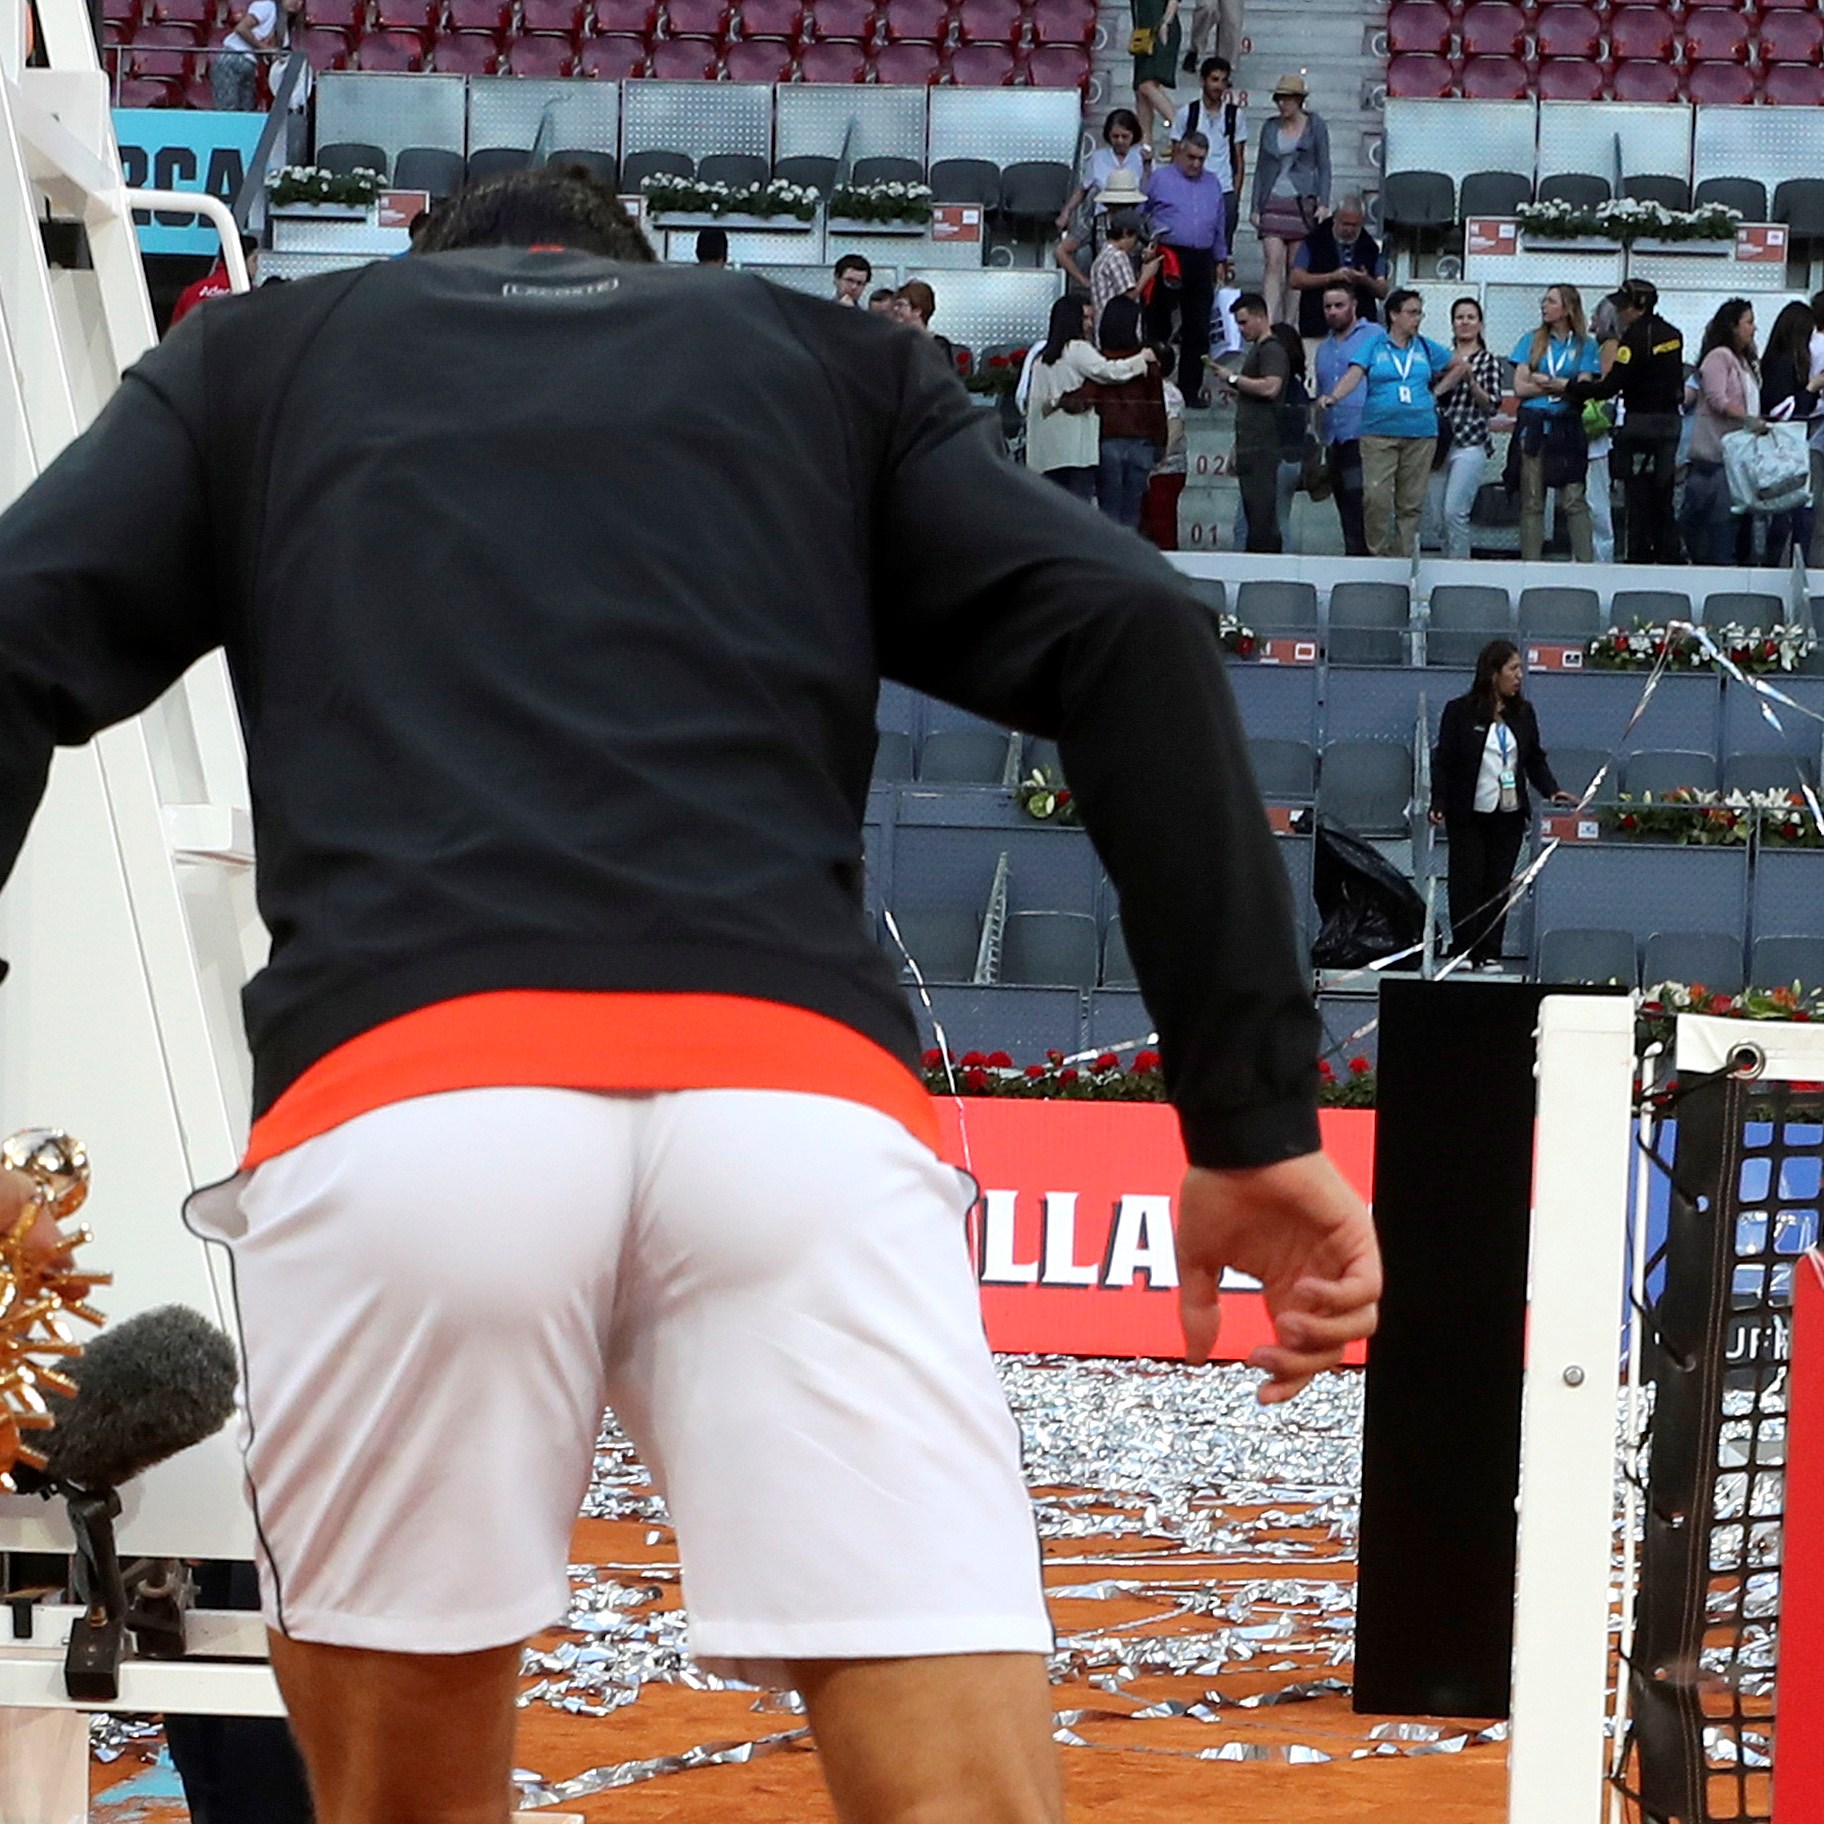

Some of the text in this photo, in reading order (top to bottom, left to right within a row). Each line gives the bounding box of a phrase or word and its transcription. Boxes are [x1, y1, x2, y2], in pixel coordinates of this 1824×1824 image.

[119, 145, 244, 228] RCA
[1197, 455, 1225, 475] 02
[1191, 523, 1217, 544] 01
[981, 1190, 1179, 1288] LLA
